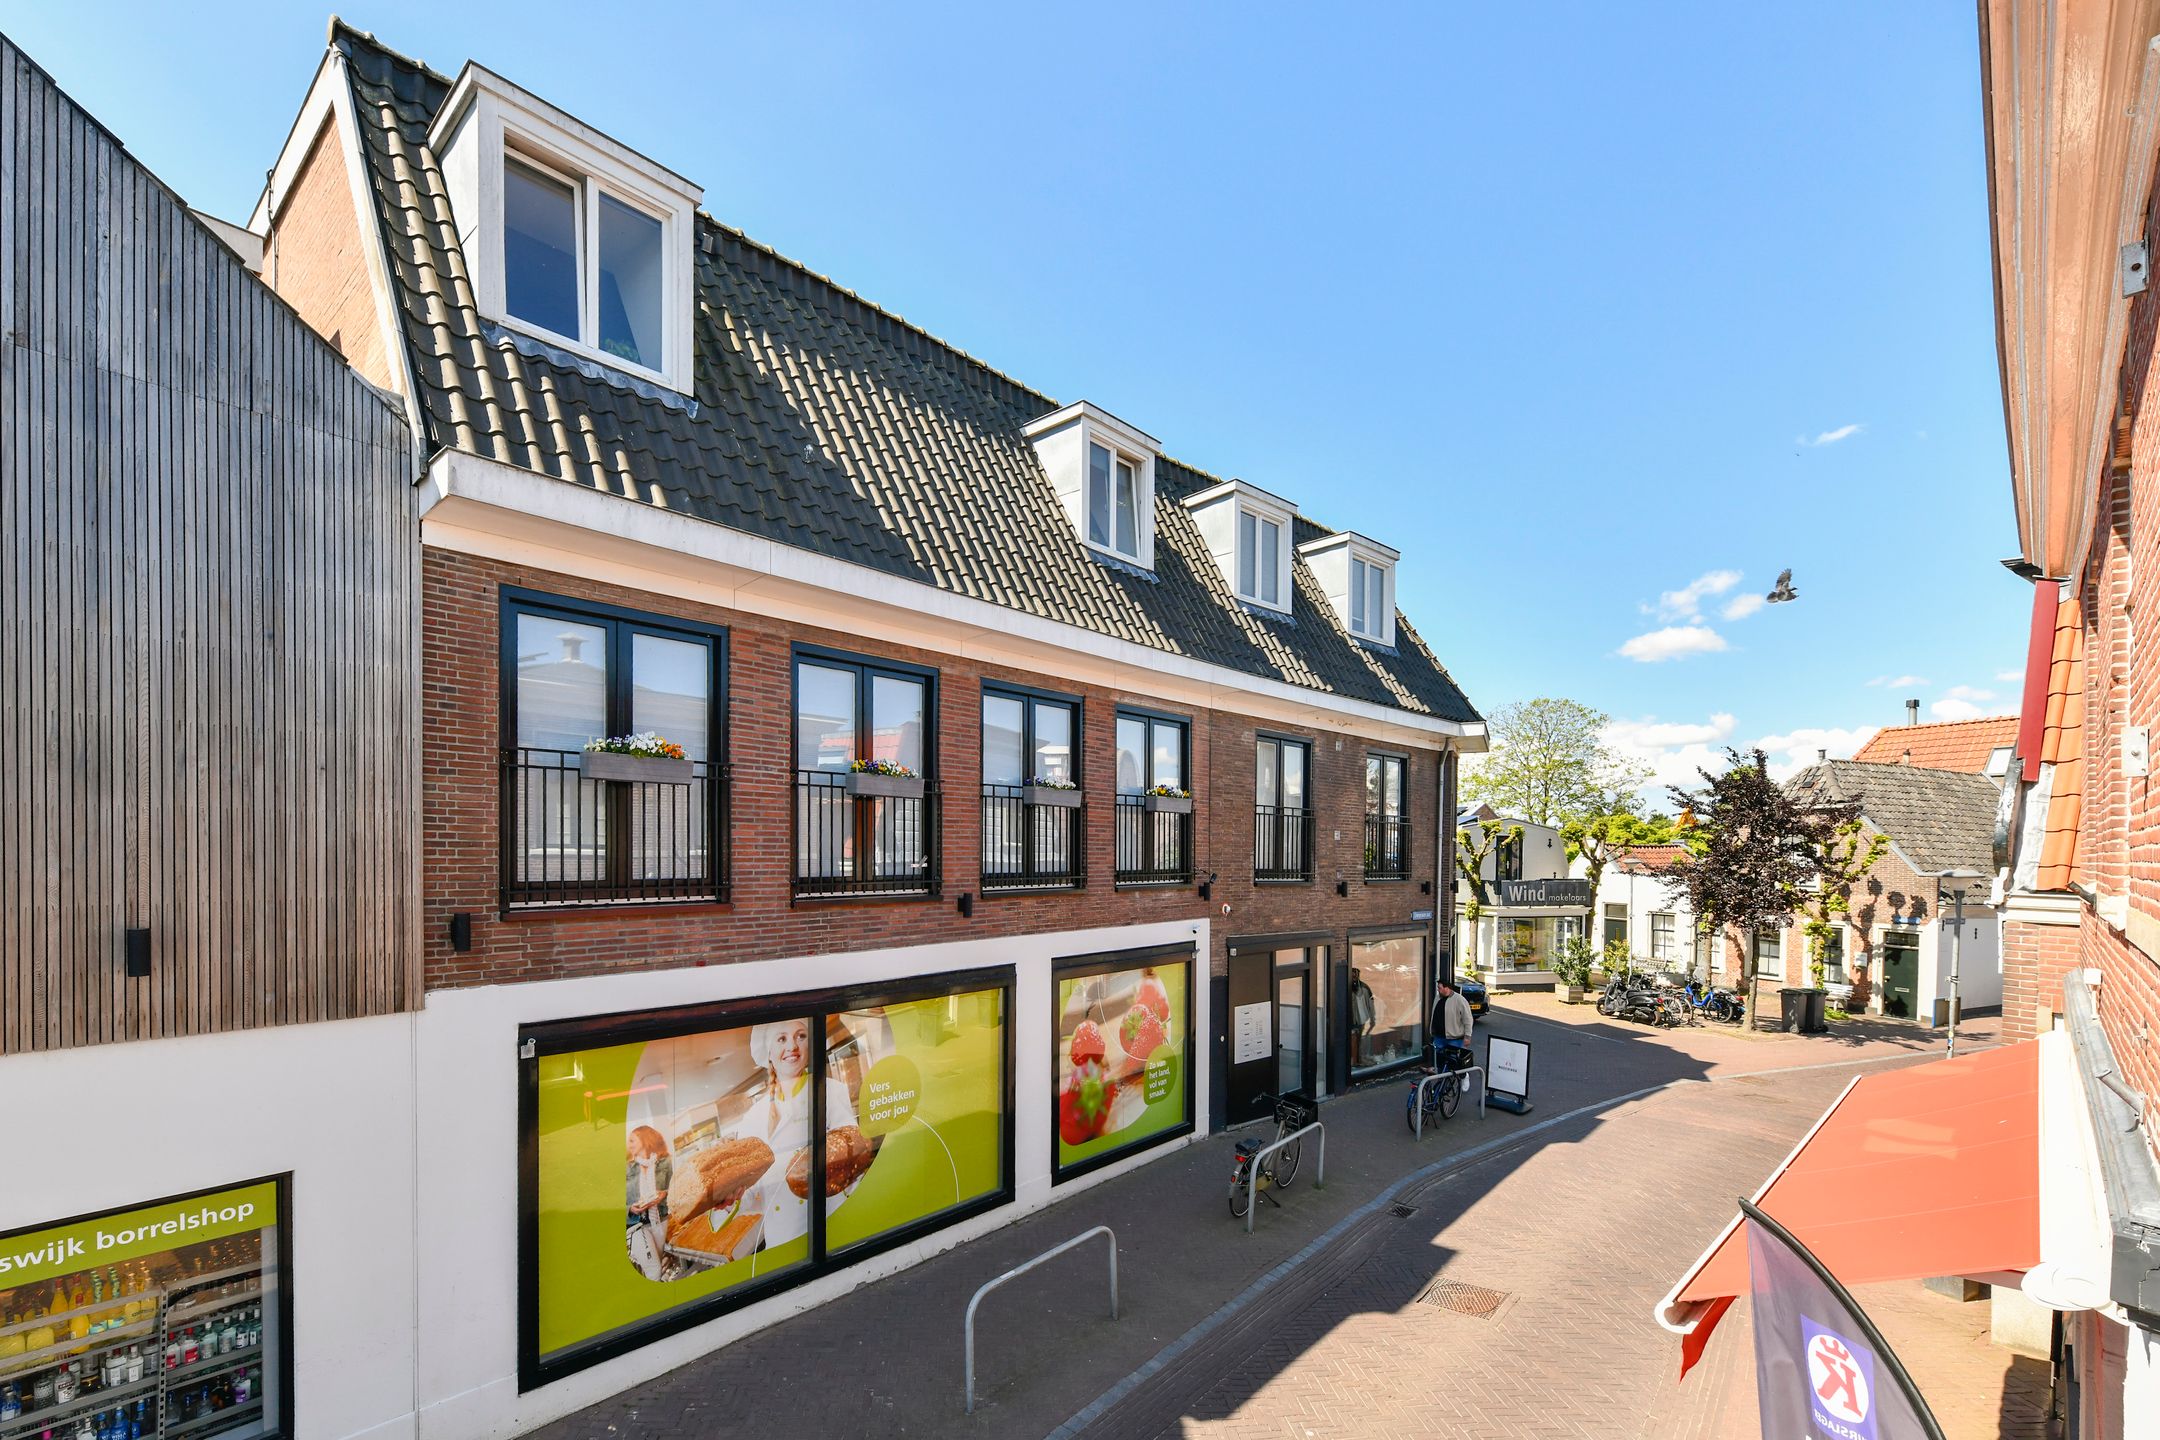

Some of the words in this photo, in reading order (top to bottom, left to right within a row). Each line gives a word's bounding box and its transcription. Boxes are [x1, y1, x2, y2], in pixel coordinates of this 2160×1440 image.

[1508, 884, 1546, 902] Wind
[1548, 893, 1587, 902] makelaars
[1149, 1071, 1158, 1079] het
[869, 1082, 890, 1093] Vers
[1149, 1080, 1158, 1088] vol
[869, 1090, 915, 1110] gebakken
[869, 1110, 891, 1121] voor
[894, 1105, 908, 1118] jou
[0, 1237, 86, 1273] swijk
[96, 1202, 254, 1250] borrelshop
